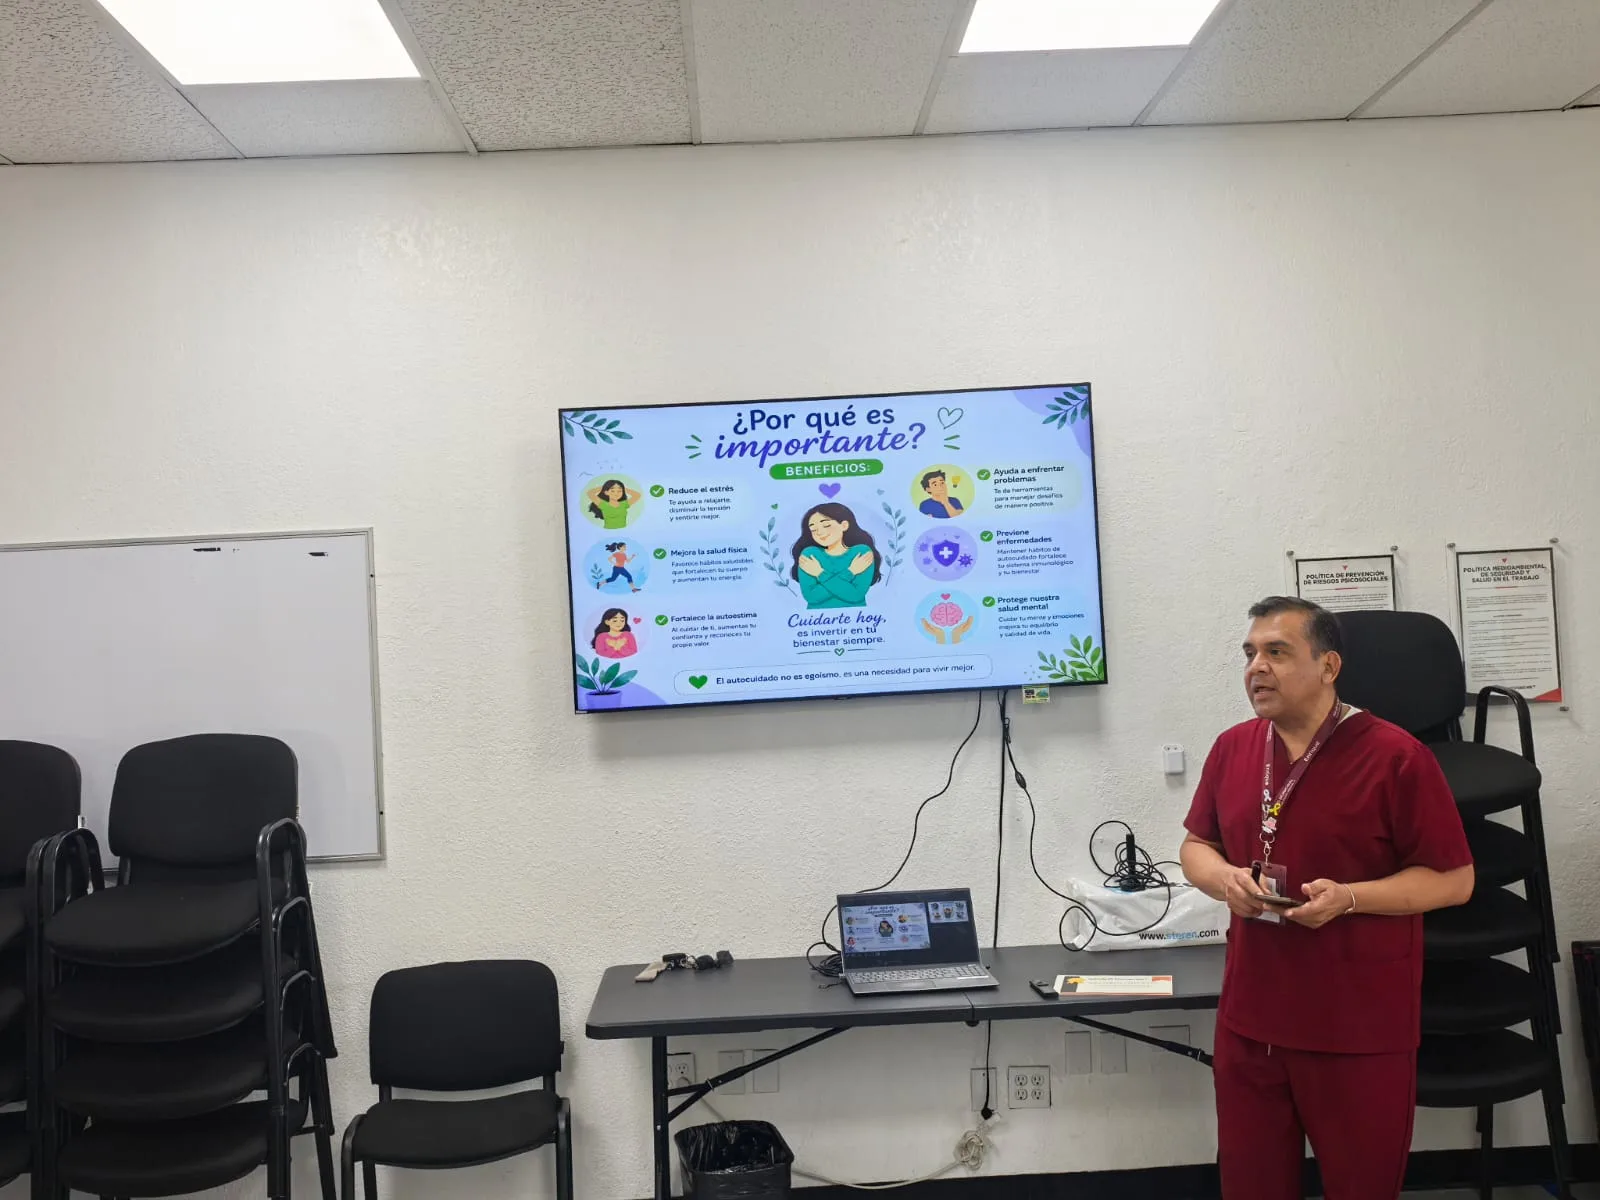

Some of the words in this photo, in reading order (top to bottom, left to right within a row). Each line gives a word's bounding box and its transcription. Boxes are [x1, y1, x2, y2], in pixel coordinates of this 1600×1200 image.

[733, 409, 796, 435] ¿Por
[805, 404, 857, 434] qué
[866, 408, 895, 425] es
[714, 422, 926, 469] importante?
[785, 462, 871, 477] BENEFICIOS:
[993, 467, 1019, 476] Ayuda
[1027, 465, 1065, 473] enfrentar
[993, 475, 1037, 485] problemas
[668, 487, 699, 495] Reduce
[996, 529, 1030, 537] Previene
[996, 536, 1053, 545] enfermedades
[670, 549, 697, 557] Mejora
[706, 547, 727, 555] salud
[727, 546, 748, 554] física
[1306, 572, 1334, 580] POLÍTICA
[1345, 570, 1385, 578] PREVENCIÓN
[1340, 576, 1389, 584] PSICOSOCIALES
[997, 596, 1028, 604] Protege
[1029, 594, 1060, 602] nuestra
[998, 604, 1019, 612] salud
[1021, 603, 1049, 611] mental
[670, 614, 706, 622] Fortalece
[715, 612, 758, 620] autoestima
[788, 612, 851, 628] Cuidarte
[856, 610, 887, 628] hoy,
[811, 627, 847, 636] invertir
[866, 626, 877, 634] tu
[793, 638, 840, 647] bienestar
[843, 636, 885, 646] siempre.
[716, 677, 725, 685] El
[726, 674, 779, 684] autocuidado
[871, 666, 911, 676] necesidad
[912, 667, 931, 675] para
[951, 663, 975, 672] mejor.
[1139, 929, 1220, 940] www.steren.com
